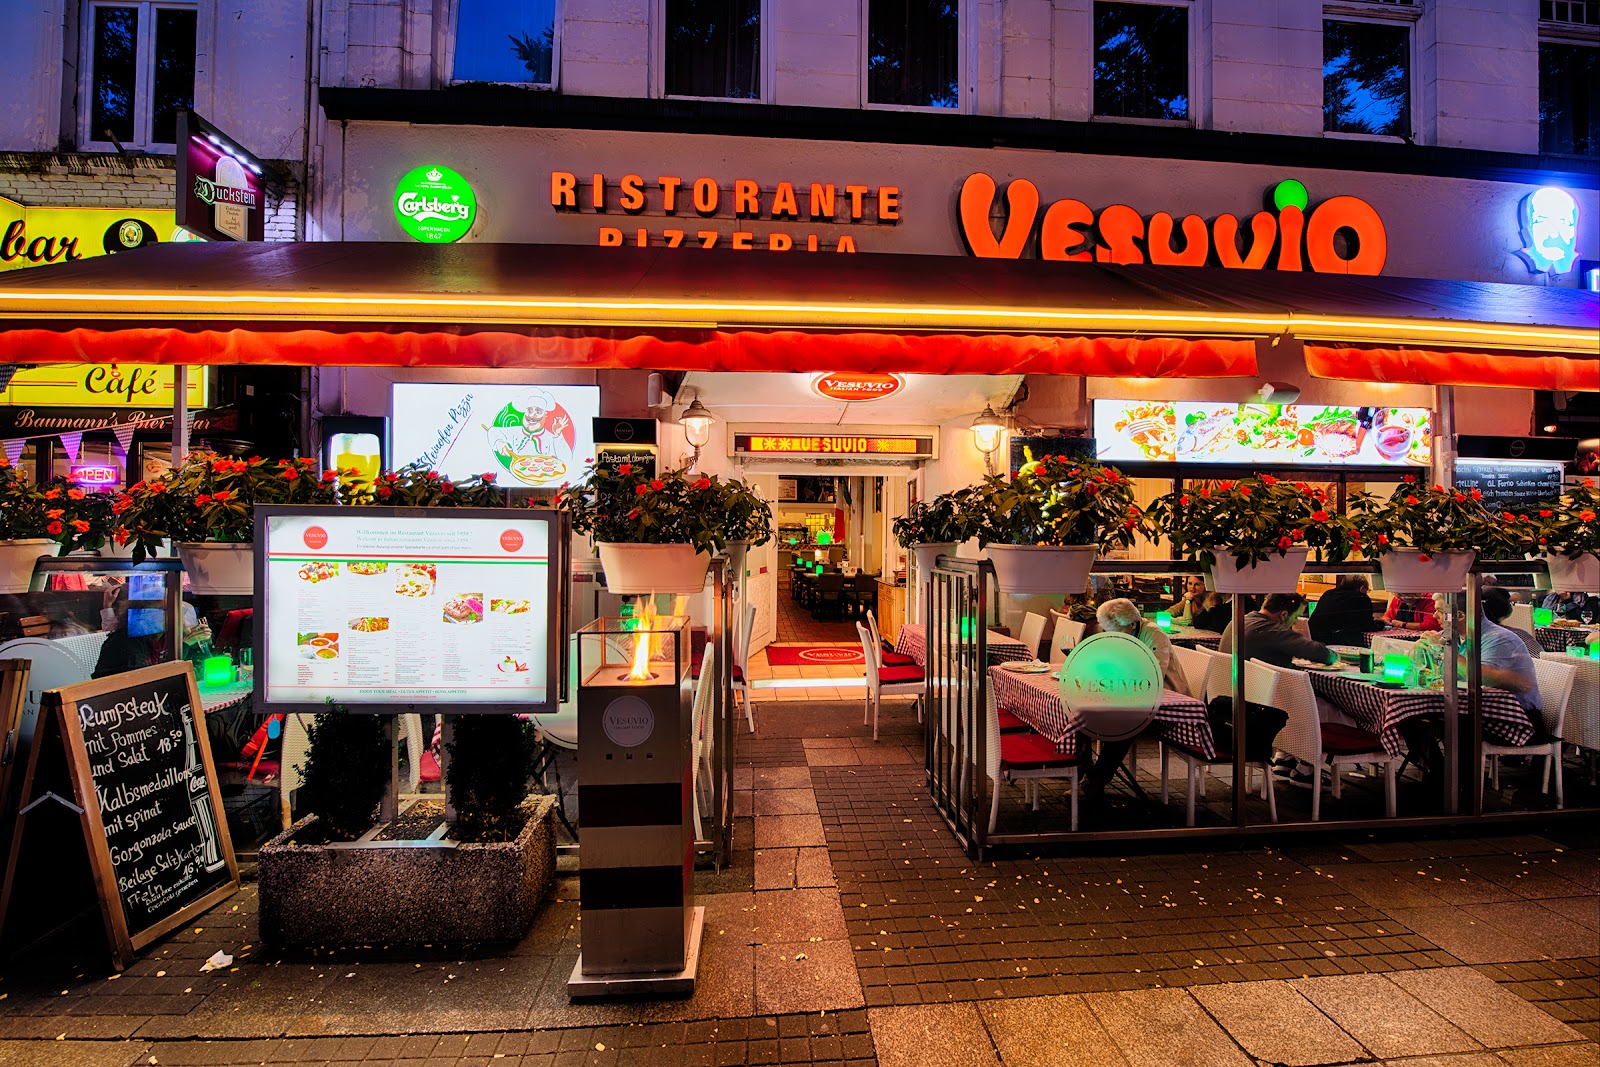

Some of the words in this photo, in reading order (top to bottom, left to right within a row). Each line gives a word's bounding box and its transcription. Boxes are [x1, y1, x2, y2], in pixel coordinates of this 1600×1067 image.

[194, 175, 256, 205] Duckstein
[551, 171, 900, 222] RISTORANTE
[398, 192, 469, 222] Carlsberg
[85, 366, 158, 402] Café
[824, 380, 894, 389] VESUVIO
[14, 409, 119, 428] Baumann's
[128, 410, 210, 430] Bier-ar
[448, 392, 474, 424] Pizza
[75, 469, 113, 481] OPEN
[1074, 678, 1151, 693] VESUVIO
[609, 716, 649, 725] VESUVIO
[104, 725, 158, 757] Pommes
[117, 743, 151, 768] Salat
[104, 815, 123, 837] mit
[109, 826, 172, 865] Gorgonzola
[118, 866, 158, 892] Beilage
